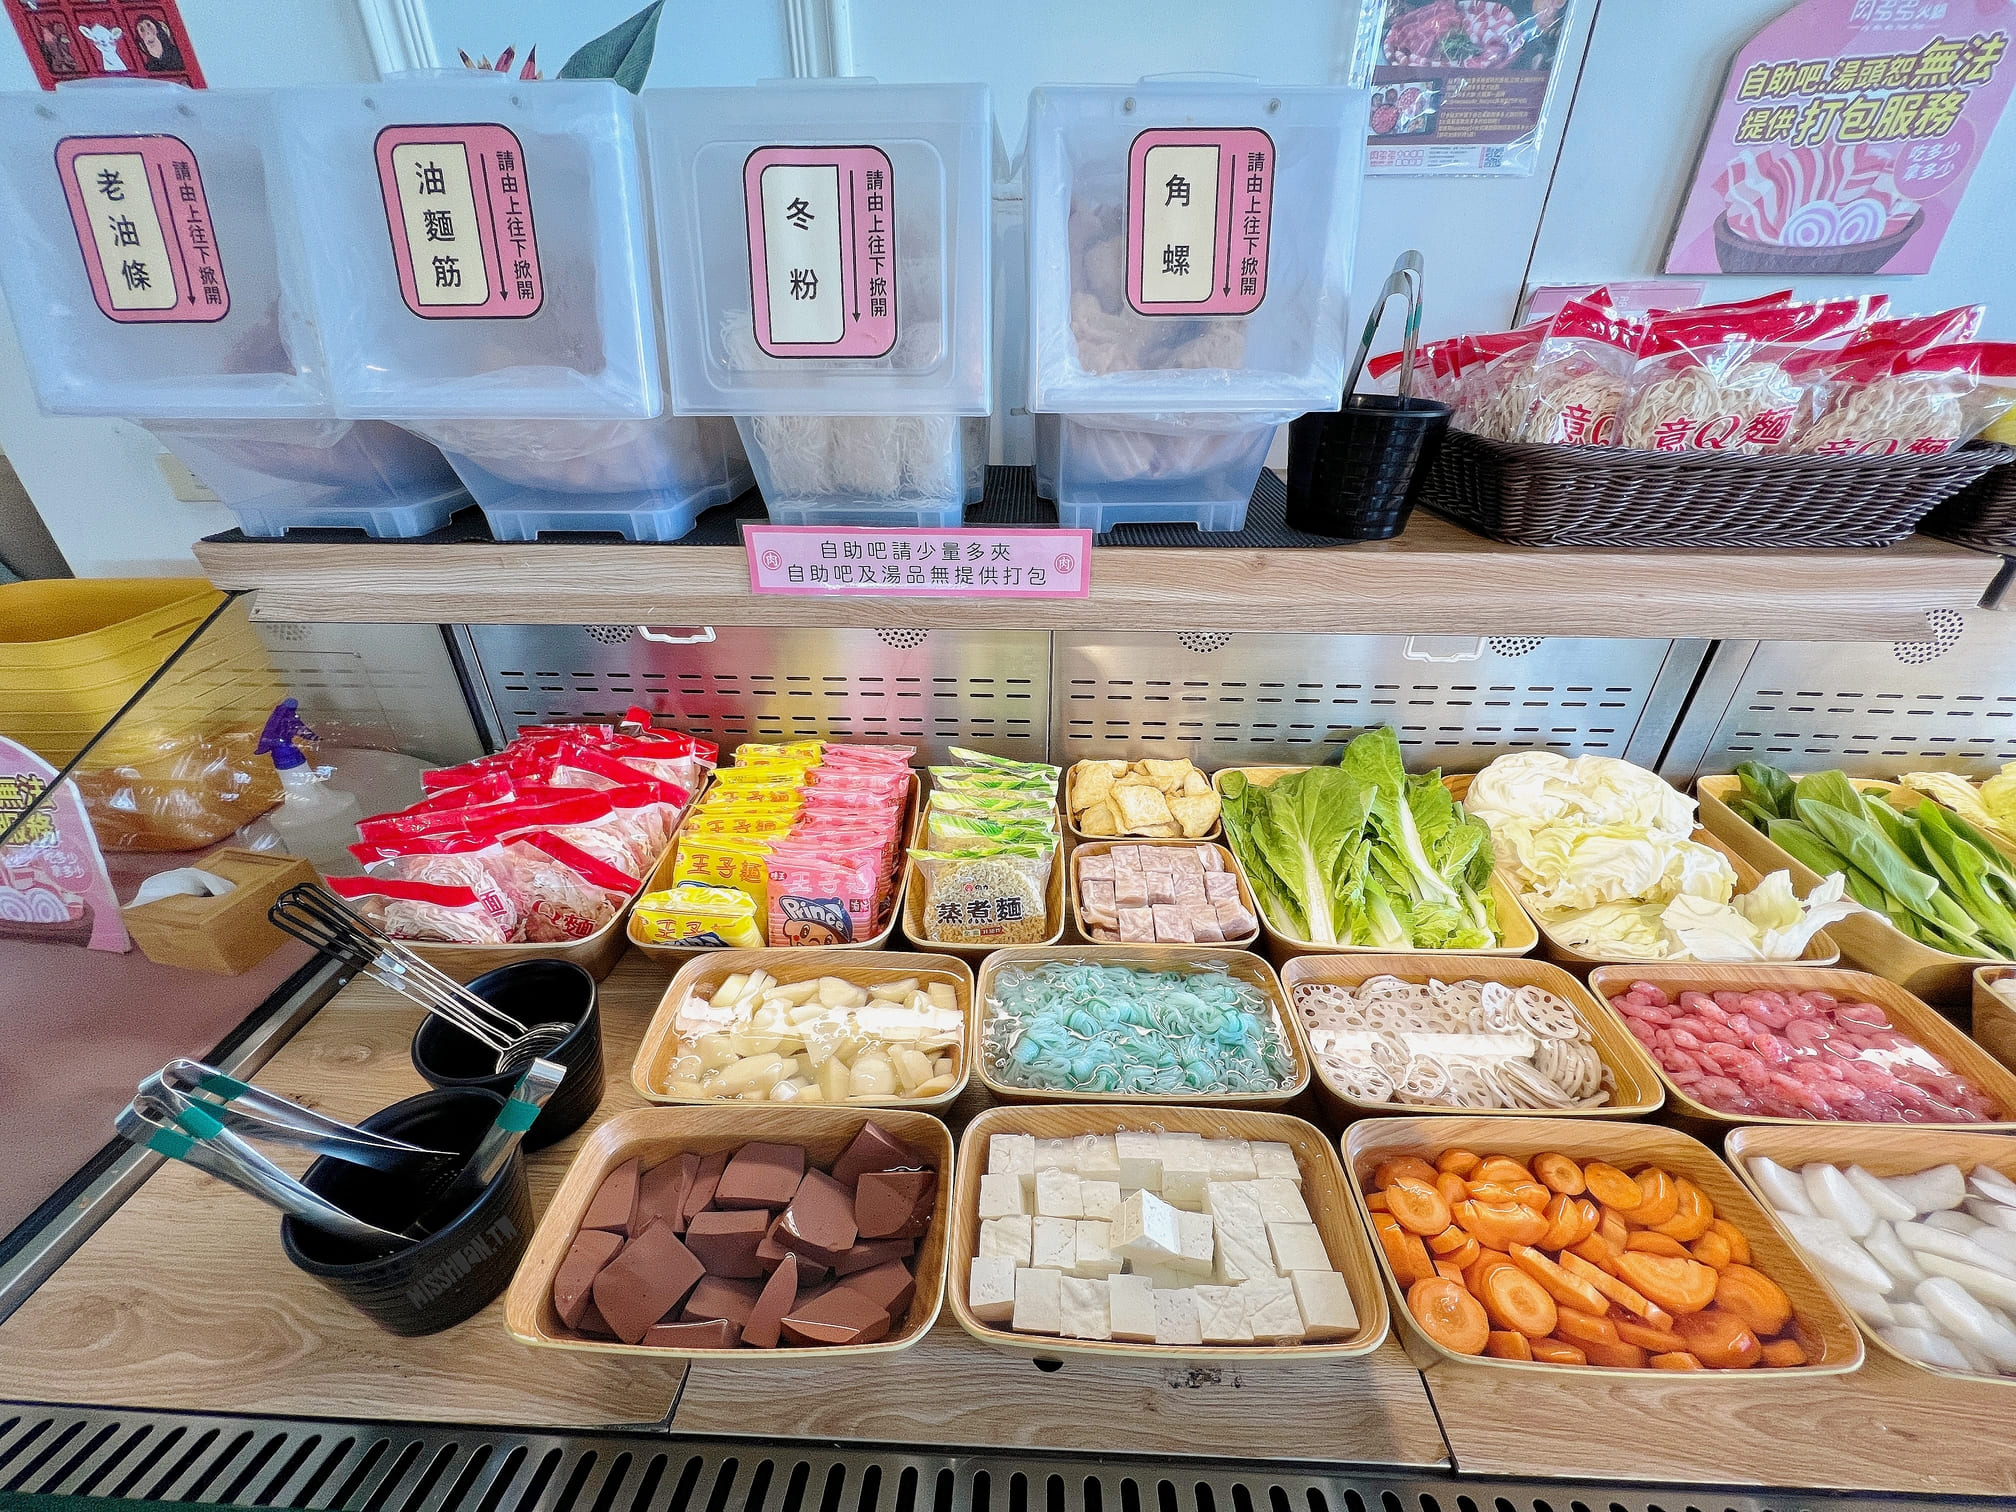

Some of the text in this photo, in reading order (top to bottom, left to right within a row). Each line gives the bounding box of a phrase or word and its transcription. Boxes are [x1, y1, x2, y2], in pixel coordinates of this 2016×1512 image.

[1738, 89, 1967, 143] 提供打包服務
[97, 168, 152, 291] 老油條
[172, 160, 222, 305] 請由上往下掀開
[415, 161, 462, 288] 油麵筋
[496, 150, 535, 300] 請由上往下掀開
[786, 197, 819, 300] 冬粉
[866, 169, 887, 317] 請由上往下掀開
[1162, 174, 1191, 276] 角螺
[1240, 152, 1265, 296] 請由上往下掀開
[787, 564, 1047, 586] 自助吧及湯品無提供打包
[820, 540, 1011, 562] 自助吧請少量多夾
[686, 853, 763, 884] 王子麵
[783, 898, 844, 932] Prince
